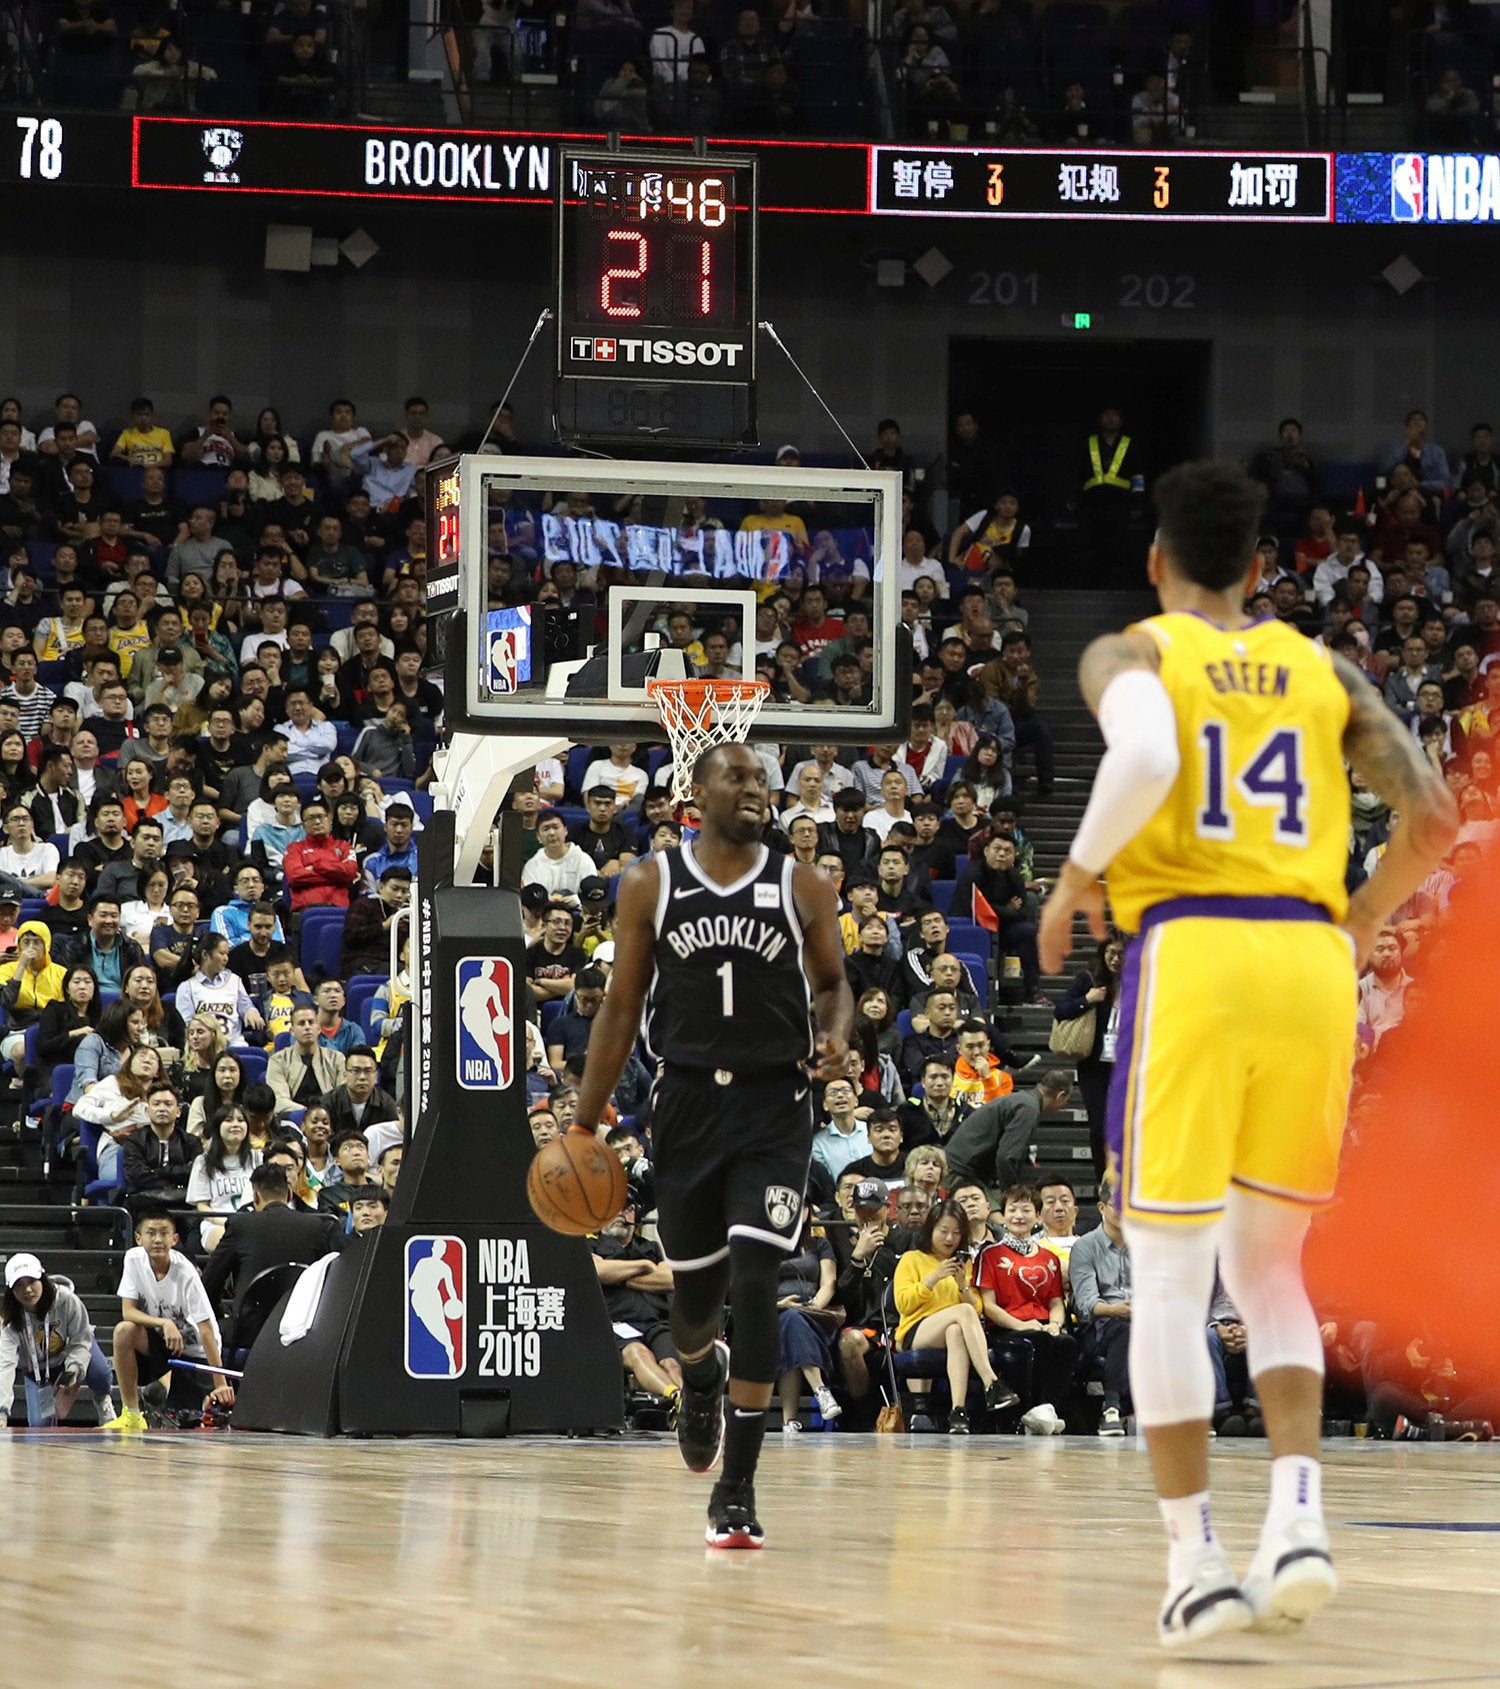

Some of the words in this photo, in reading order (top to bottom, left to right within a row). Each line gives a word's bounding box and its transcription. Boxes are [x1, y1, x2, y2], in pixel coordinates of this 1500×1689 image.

[16, 116, 64, 180] 78
[364, 138, 550, 191] BROOKLYN
[638, 178, 726, 227] 1:46
[892, 159, 954, 199] 暂停
[986, 163, 1004, 206] 3
[1058, 162, 1120, 202] 犯规
[1153, 166, 1170, 208] 3
[1227, 162, 1299, 207] 加罚
[601, 230, 711, 318] 21
[968, 272, 1039, 306] 201
[1120, 274, 1196, 308] 202
[619, 338, 743, 367] TISSOT
[439, 514, 457, 560] 21
[492, 678, 507, 691] NBA
[1205, 659, 1290, 697] GREEN
[1197, 719, 1310, 847] 14
[666, 914, 787, 962] BROOKLYN
[195, 1001, 234, 1016] LAKERS
[716, 960, 733, 1017] 1
[465, 1059, 492, 1081] NBA
[768, 1188, 800, 1214] NETS
[478, 1239, 530, 1284] NBA
[478, 1286, 565, 1330] 上海赛
[478, 1331, 541, 1377] 2019
